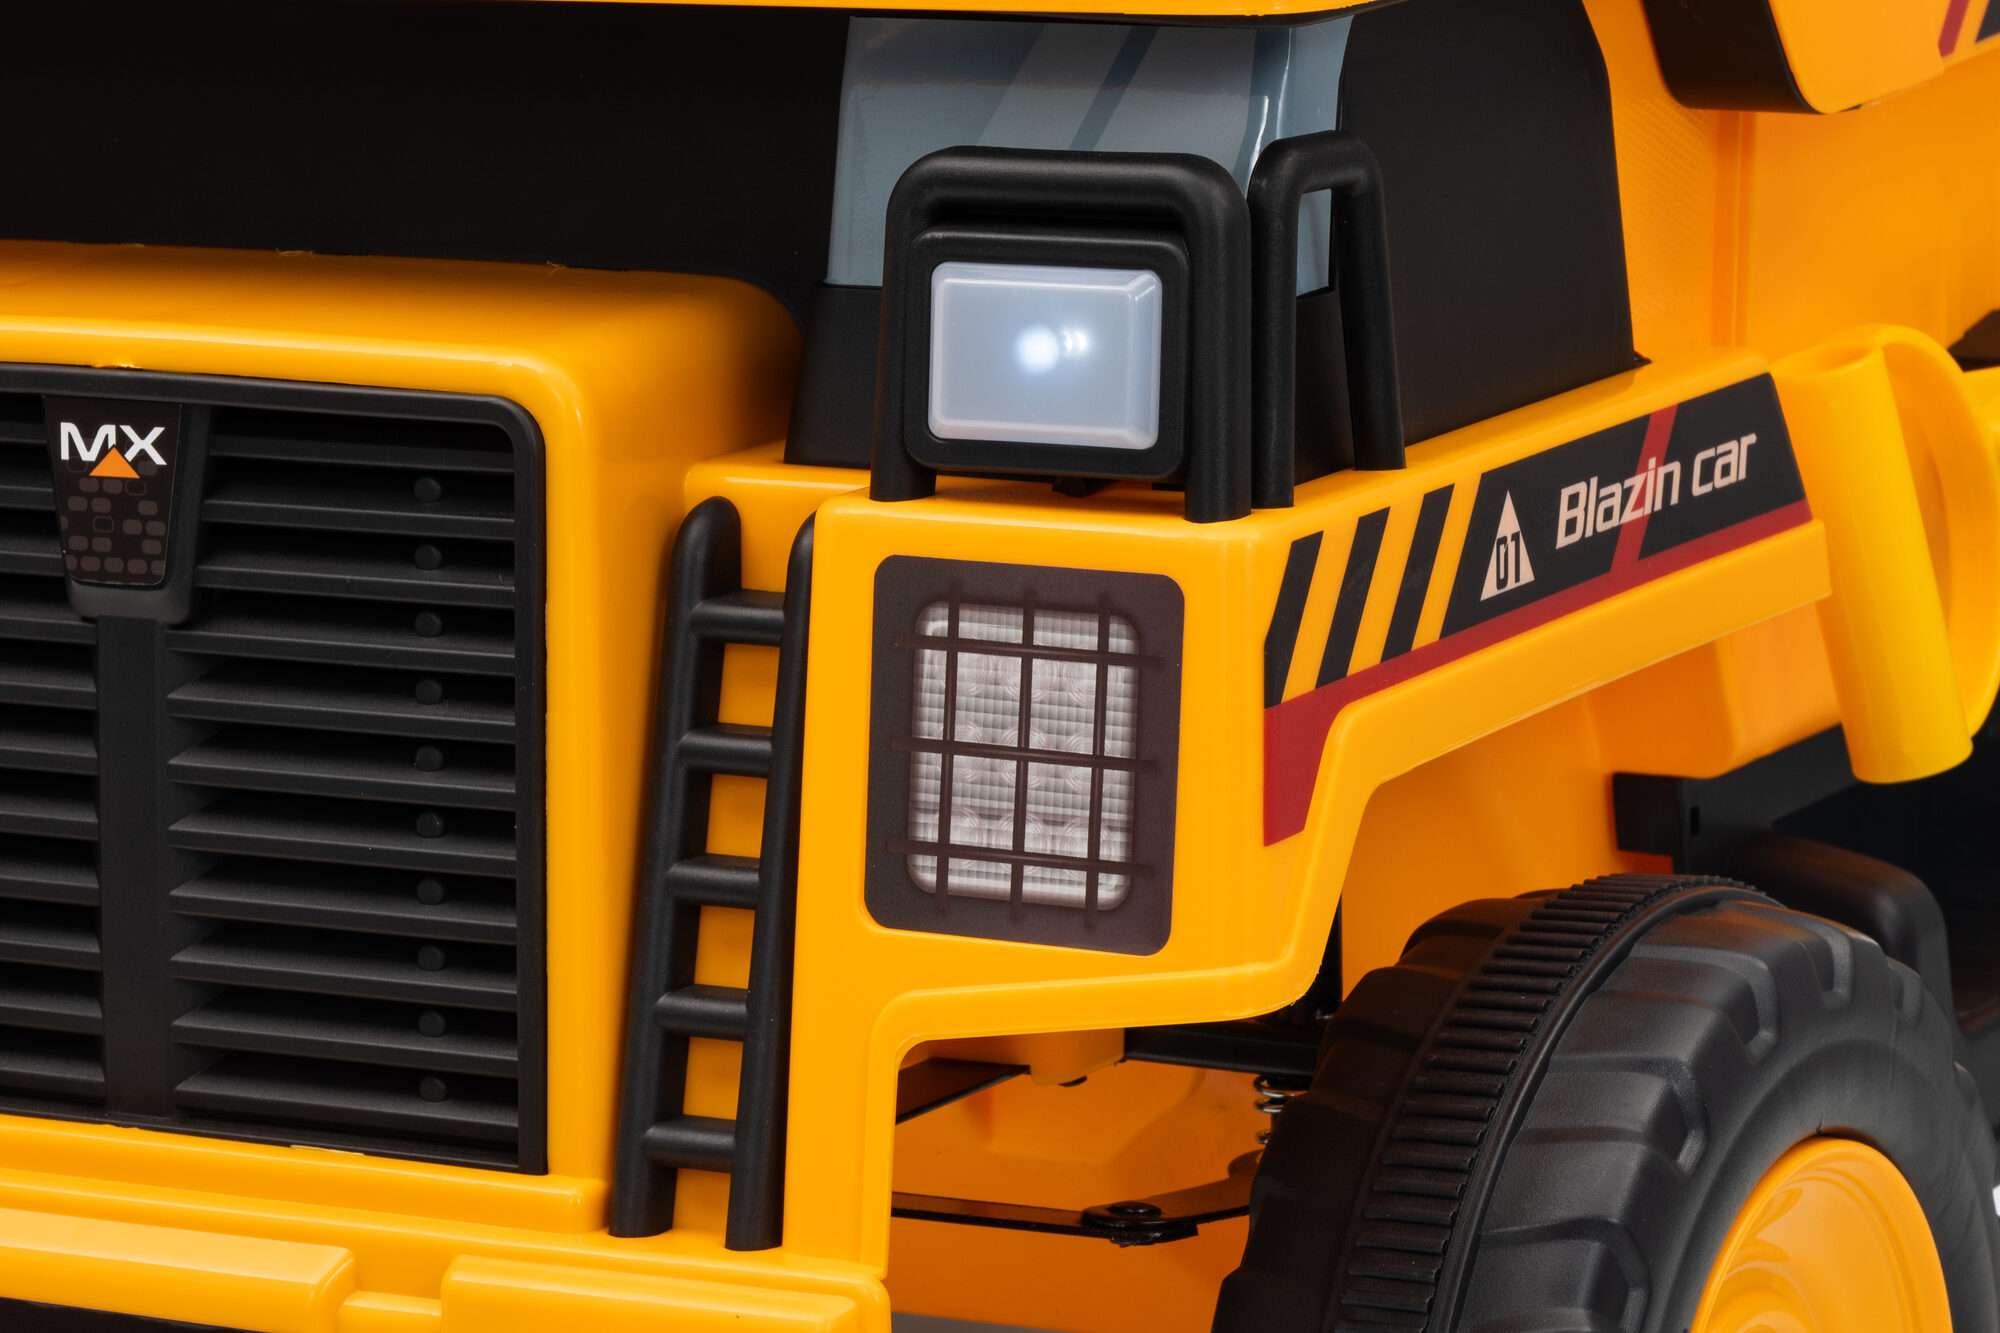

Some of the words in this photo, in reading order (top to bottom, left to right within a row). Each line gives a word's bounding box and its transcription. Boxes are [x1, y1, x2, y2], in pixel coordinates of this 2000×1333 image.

[60, 422, 167, 466] MX
[1555, 456, 1681, 550] Blazin
[1691, 433, 1757, 497] car
[1495, 530, 1521, 591] 01
